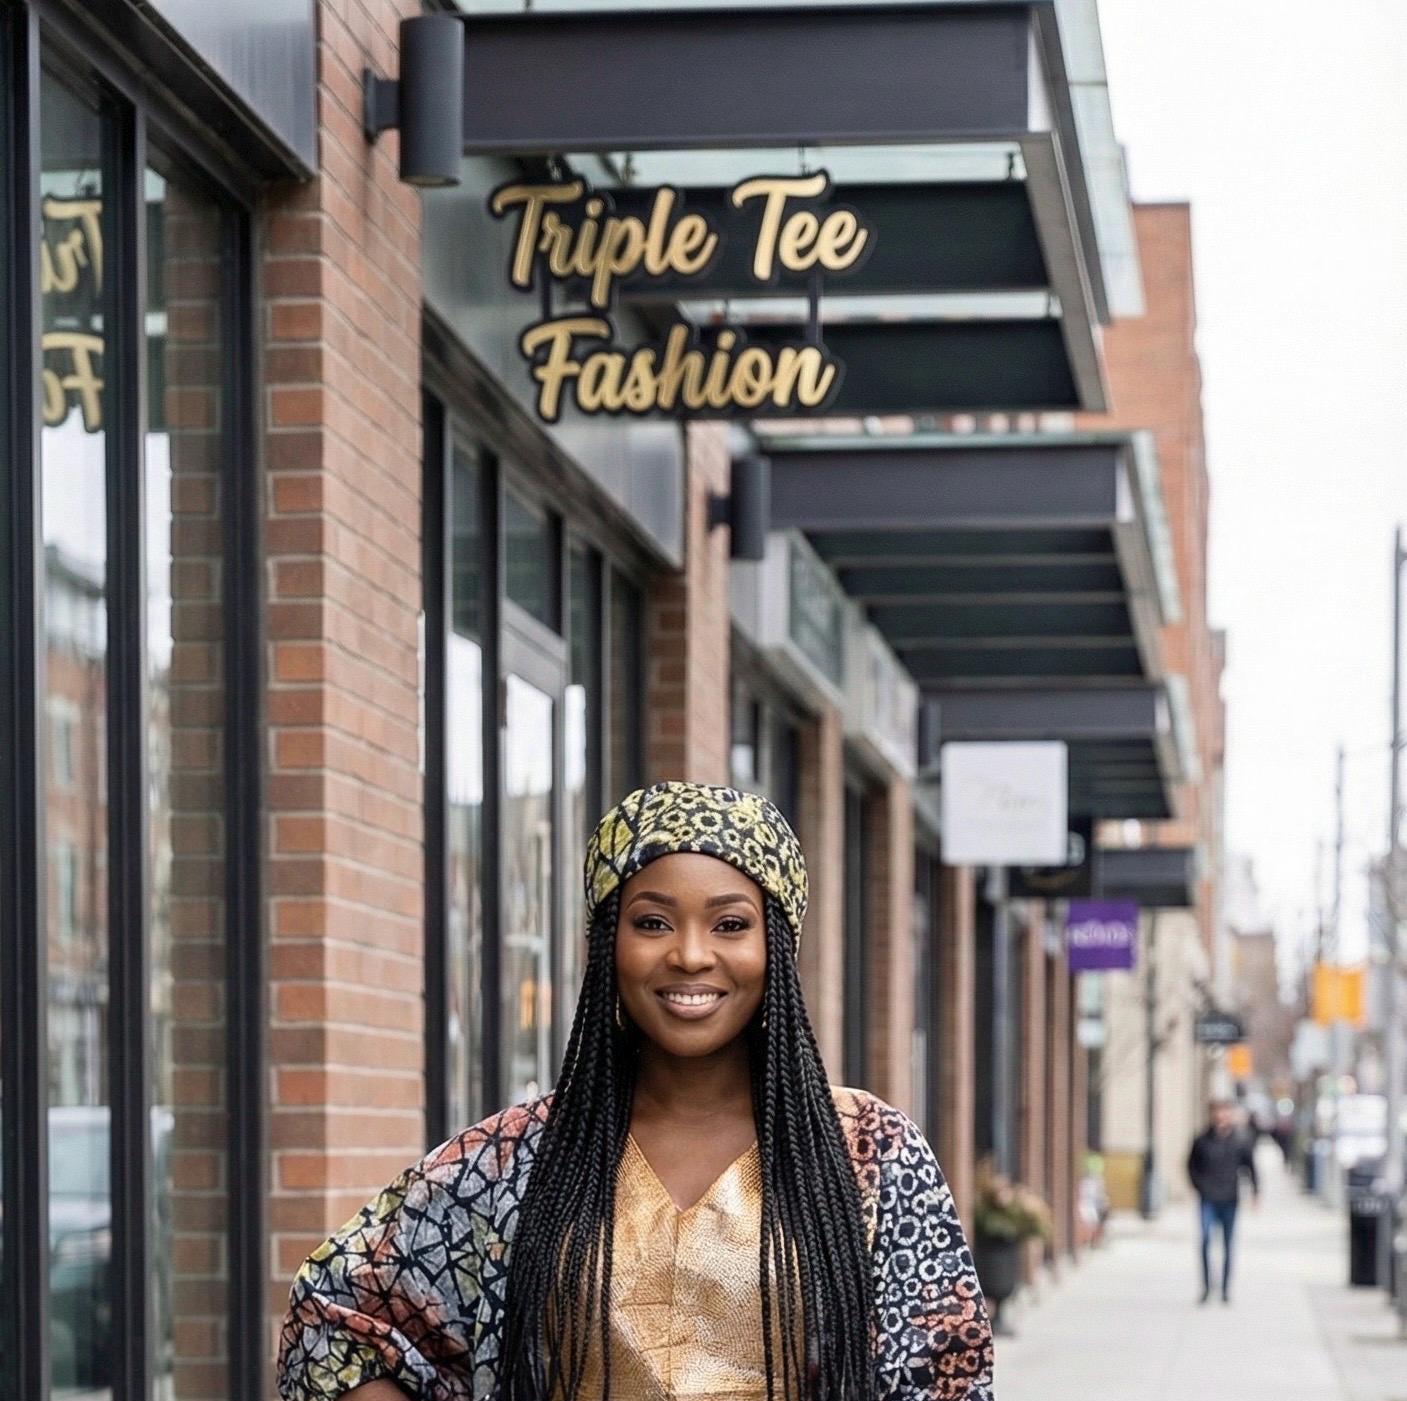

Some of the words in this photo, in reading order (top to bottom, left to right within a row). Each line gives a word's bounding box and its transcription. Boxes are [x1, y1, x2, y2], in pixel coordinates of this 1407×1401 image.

[492, 180, 719, 308] Triple
[732, 173, 869, 281] Tee
[521, 317, 836, 420] Fashion
